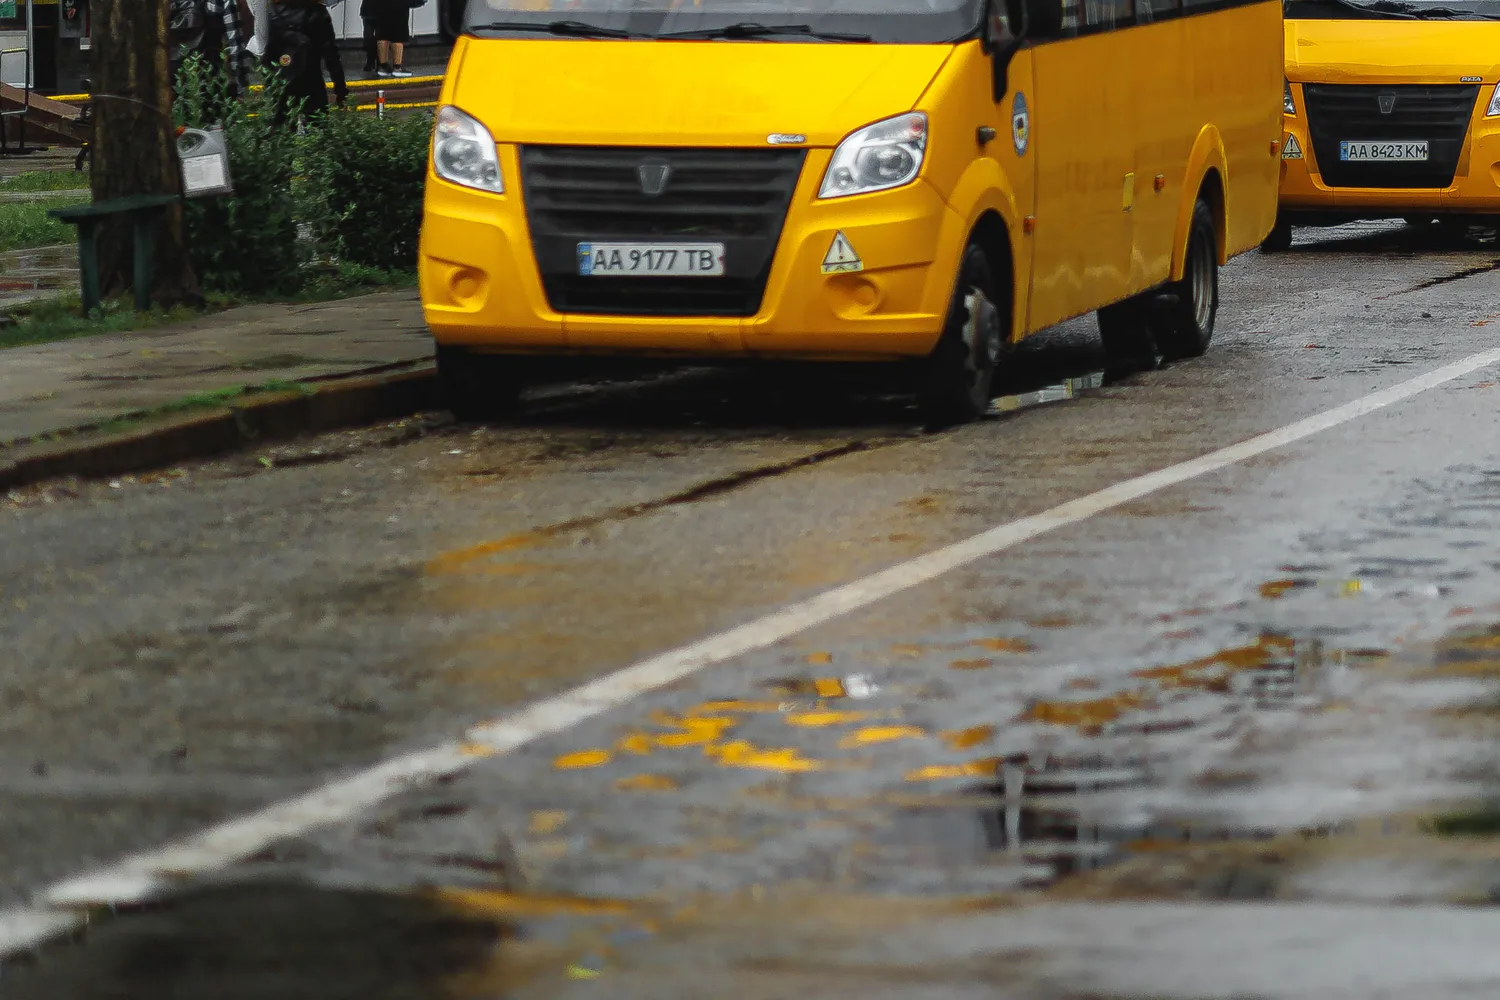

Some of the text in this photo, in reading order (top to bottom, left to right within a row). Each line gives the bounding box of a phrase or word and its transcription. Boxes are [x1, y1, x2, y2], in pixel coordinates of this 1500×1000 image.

[1349, 144, 1368, 158] AA
[1371, 144, 1402, 158] 8423
[1405, 144, 1426, 158] KM
[593, 249, 623, 270] AA
[629, 249, 679, 270] 9177
[683, 249, 714, 271] TB
